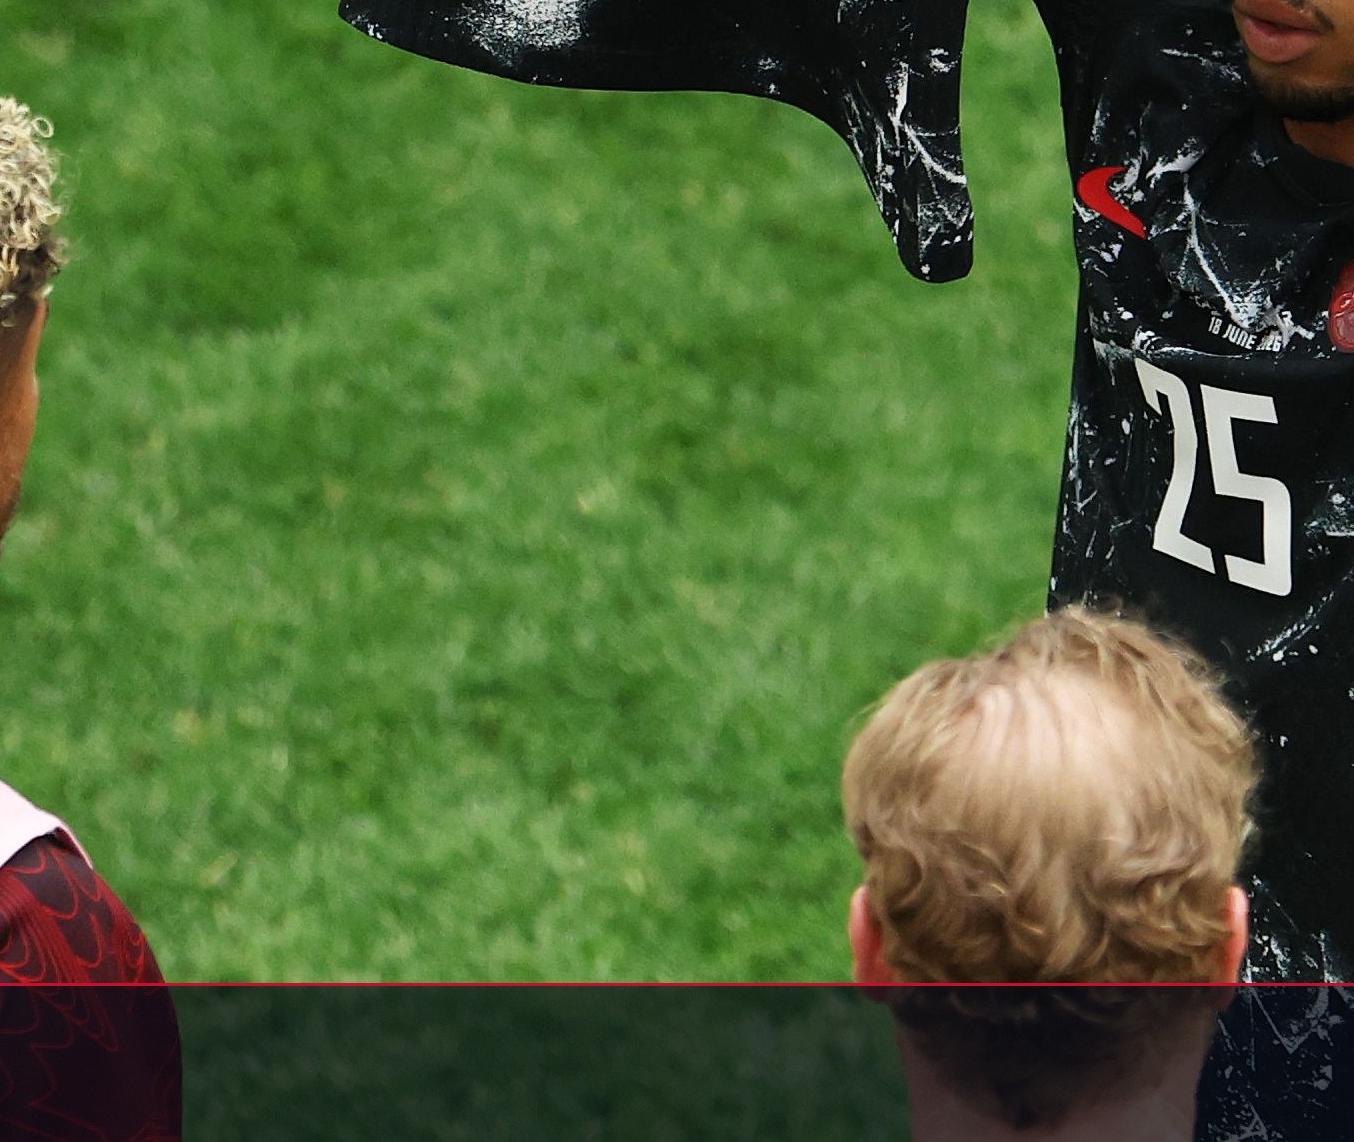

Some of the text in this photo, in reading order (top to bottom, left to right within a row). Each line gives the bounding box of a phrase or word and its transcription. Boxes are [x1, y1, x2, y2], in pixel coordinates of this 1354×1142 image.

[1207, 316, 1223, 335] 18
[1222, 324, 1257, 350] JUNE
[1134, 358, 1292, 597] 25
